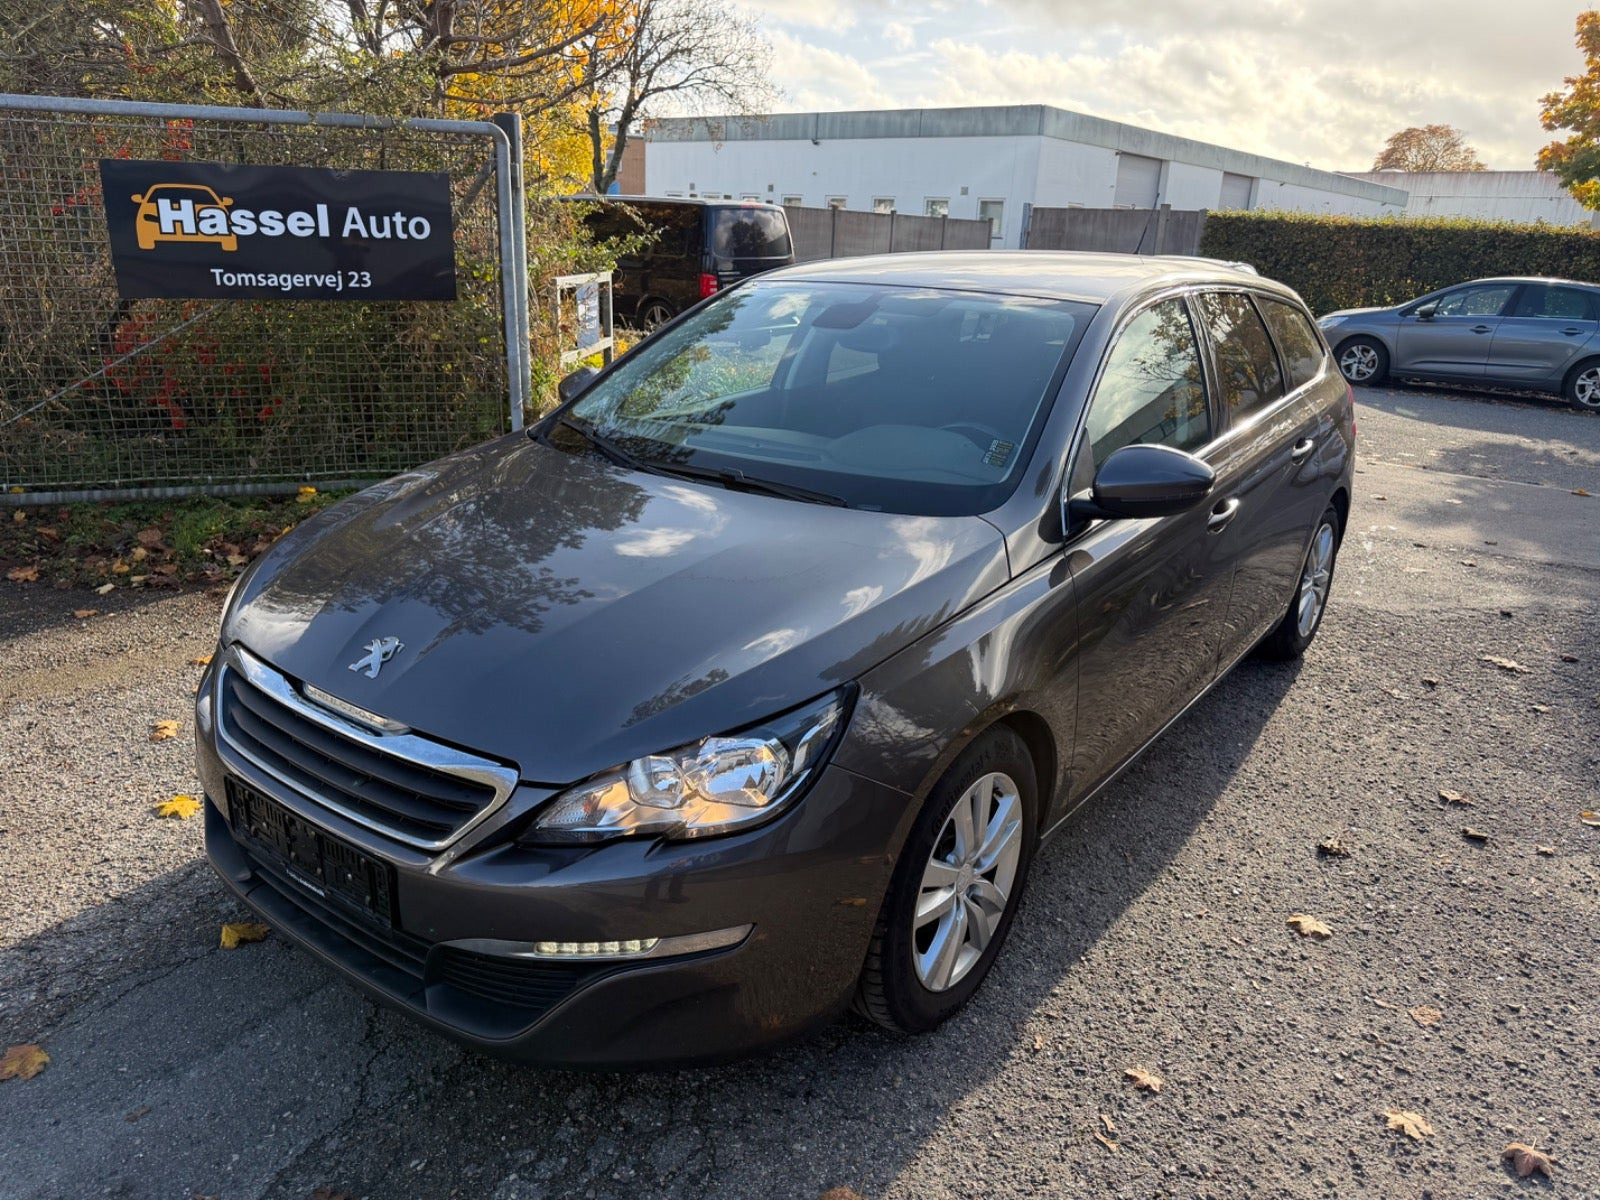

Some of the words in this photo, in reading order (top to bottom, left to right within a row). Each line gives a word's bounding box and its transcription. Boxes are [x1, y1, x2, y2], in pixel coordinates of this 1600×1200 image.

[157, 198, 331, 238] Hassel
[341, 206, 431, 240] Auto
[210, 268, 343, 292] Tomsagervej
[347, 271, 372, 289] 23
